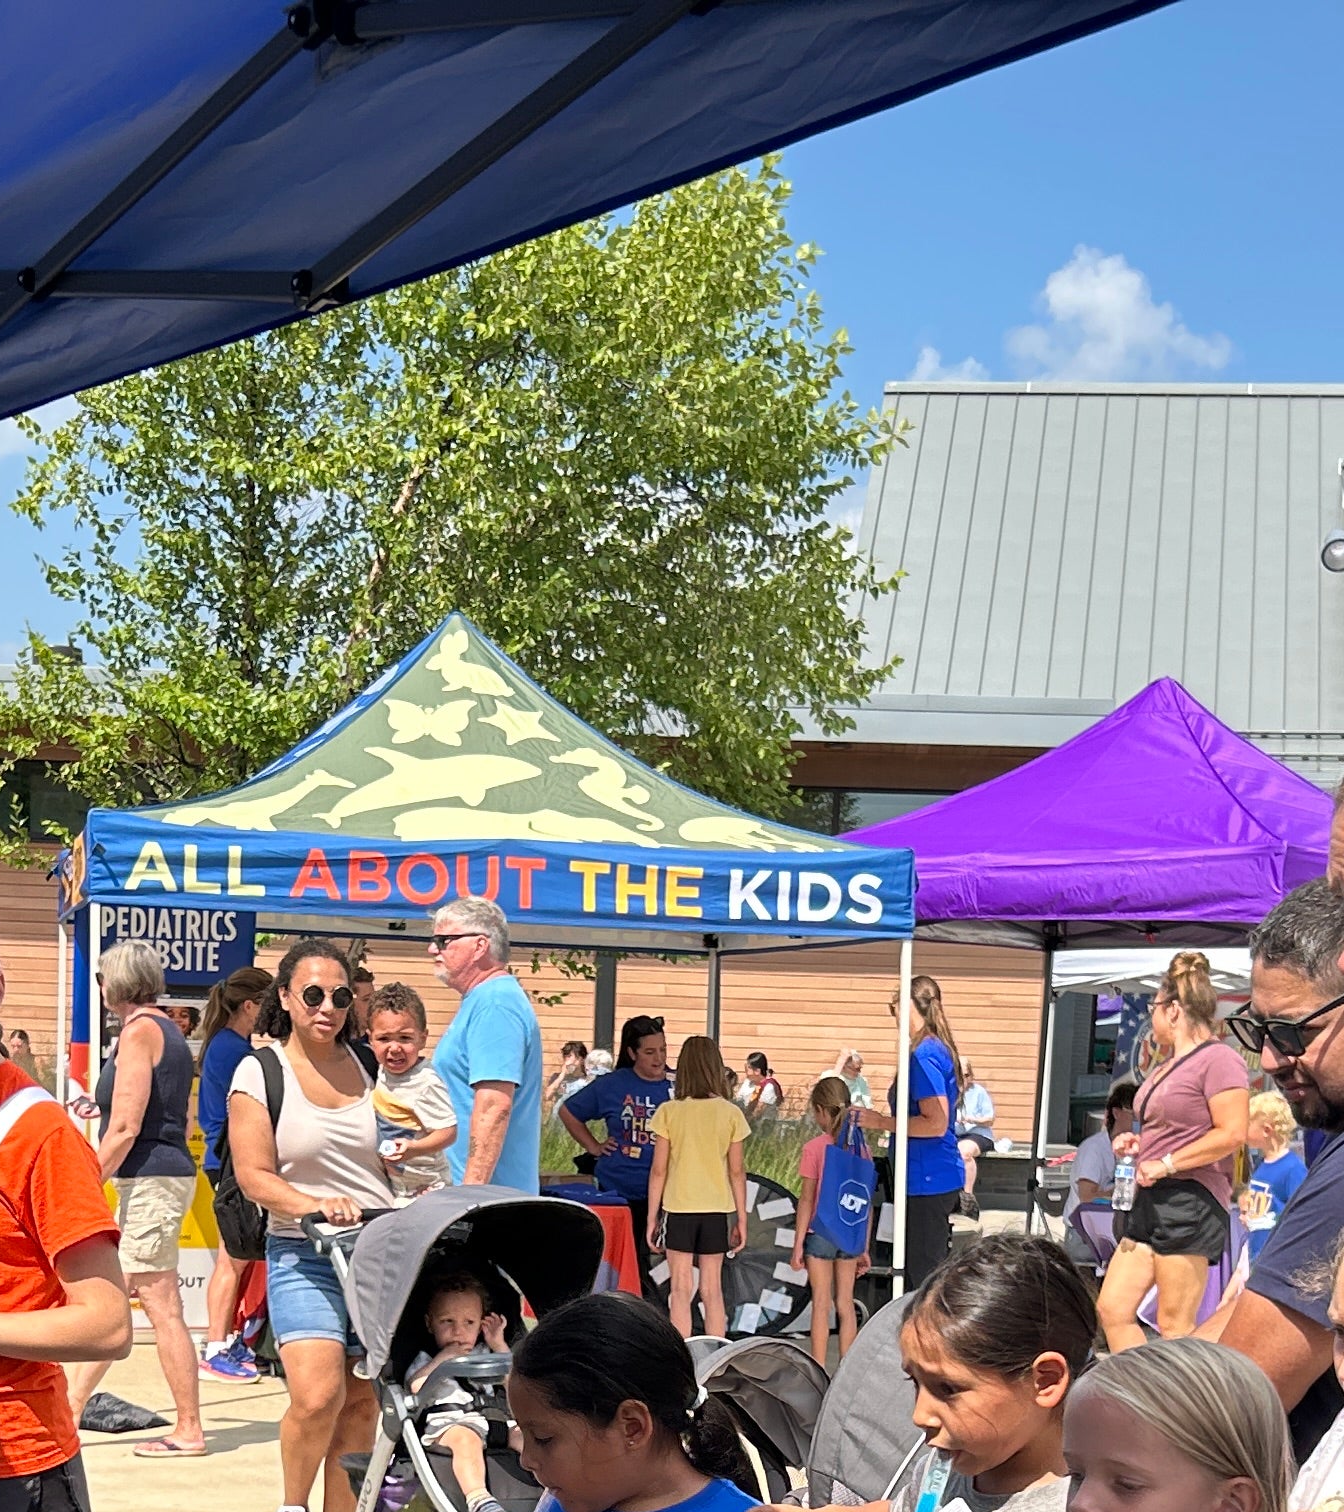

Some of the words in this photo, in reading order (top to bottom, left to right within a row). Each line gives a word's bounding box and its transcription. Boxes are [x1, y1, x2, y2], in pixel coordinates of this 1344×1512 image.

[123, 841, 265, 897] ALL
[290, 848, 546, 910] ABOUT
[569, 860, 704, 918] THE
[728, 869, 883, 925] KIDS
[100, 905, 237, 942] PEDIATRICS
[622, 1094, 656, 1108] ALL
[839, 1193, 867, 1214] ADT
